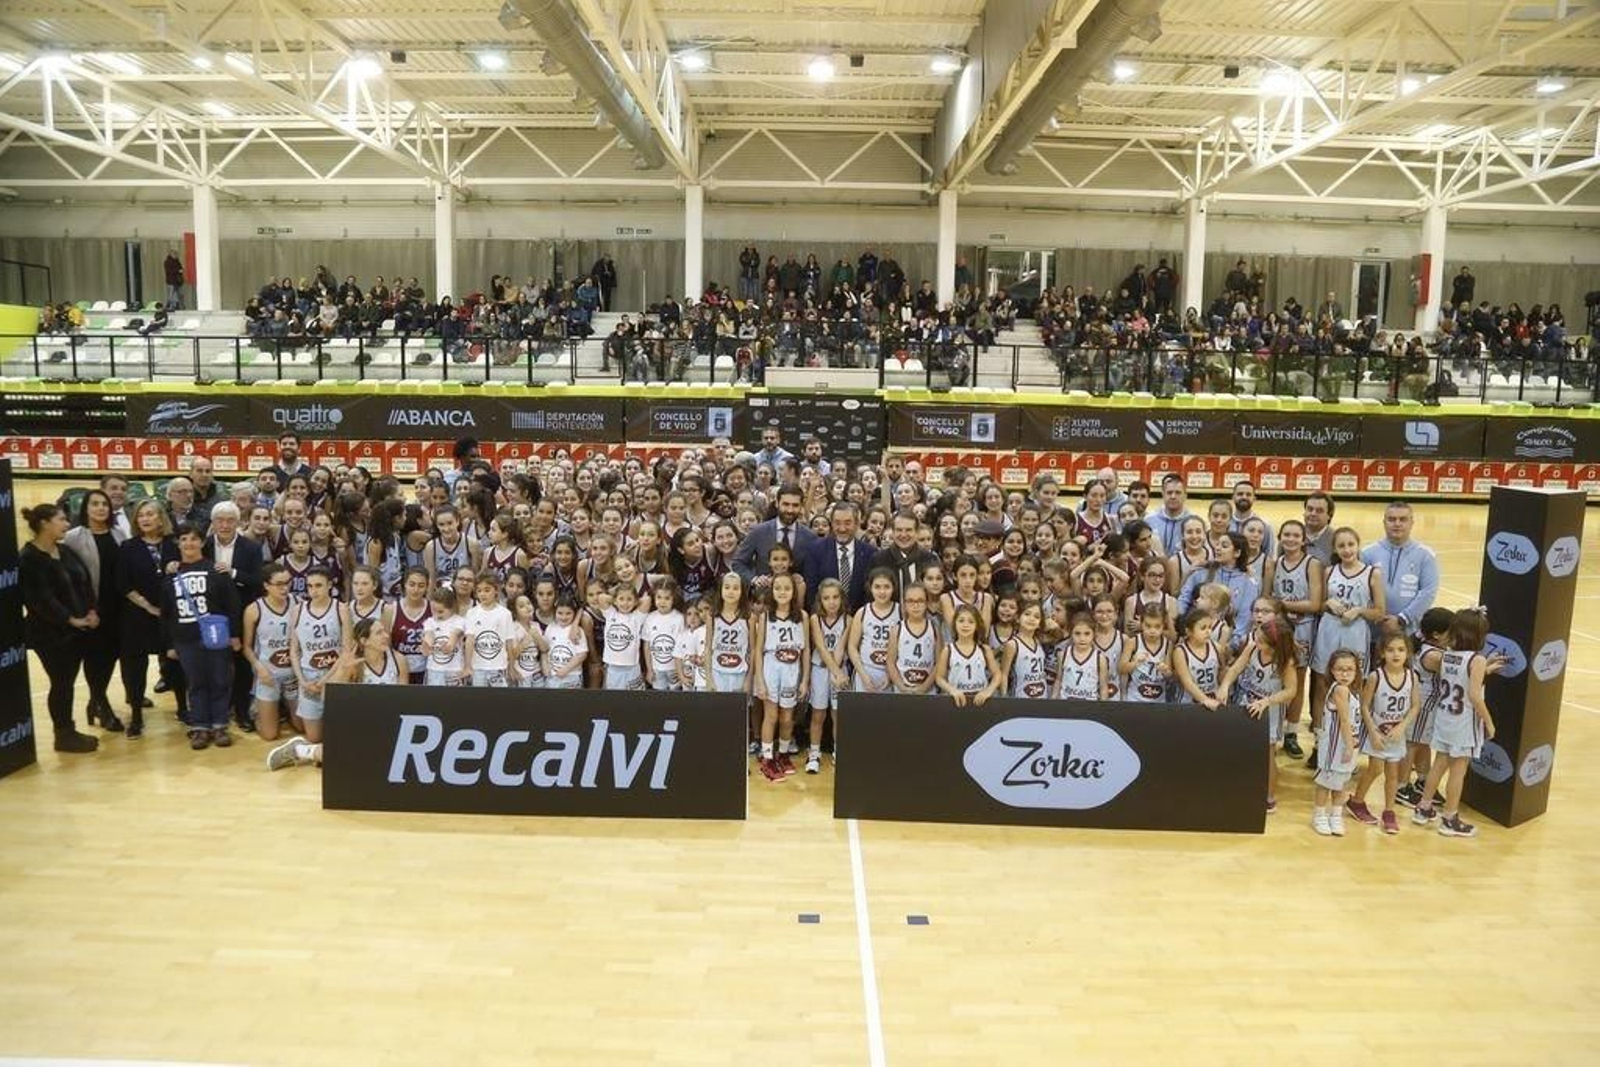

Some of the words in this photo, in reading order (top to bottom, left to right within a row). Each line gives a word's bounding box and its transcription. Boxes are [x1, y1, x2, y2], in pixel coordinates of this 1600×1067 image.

[273, 404, 343, 428] quattro
[397, 410, 476, 426] ABANCA
[546, 411, 604, 422] DEPUTACIÓN
[653, 412, 702, 422] CONCELLO
[916, 417, 965, 427] CONCELLO
[1071, 419, 1101, 428] XUNTA
[546, 422, 604, 431] PONTEVEDRA
[659, 422, 673, 431] DE
[675, 422, 698, 431] VIGO
[922, 427, 935, 436] DE
[937, 427, 960, 436] VIGO
[1167, 420, 1203, 428] DEPORTE
[1071, 428, 1083, 437] DE
[1084, 428, 1119, 438] GALICIA
[292, 577, 306, 591] 18
[1281, 579, 1294, 593] 13
[1336, 583, 1353, 599] 37
[279, 622, 288, 635] 7
[313, 624, 328, 639] 21
[778, 627, 794, 642] 21
[872, 625, 890, 641] 35
[721, 630, 739, 645] 22
[912, 643, 922, 659] 4
[965, 664, 973, 680] 1
[1030, 657, 1044, 674] 21
[1147, 661, 1156, 676] 7
[1075, 671, 1084, 686] 7
[1196, 668, 1214, 684] 25
[1255, 669, 1265, 683] 9
[1387, 696, 1405, 712] 20
[1438, 678, 1465, 716] 23
[387, 714, 679, 790] Recalvi
[1000, 736, 1104, 789] Zorka
